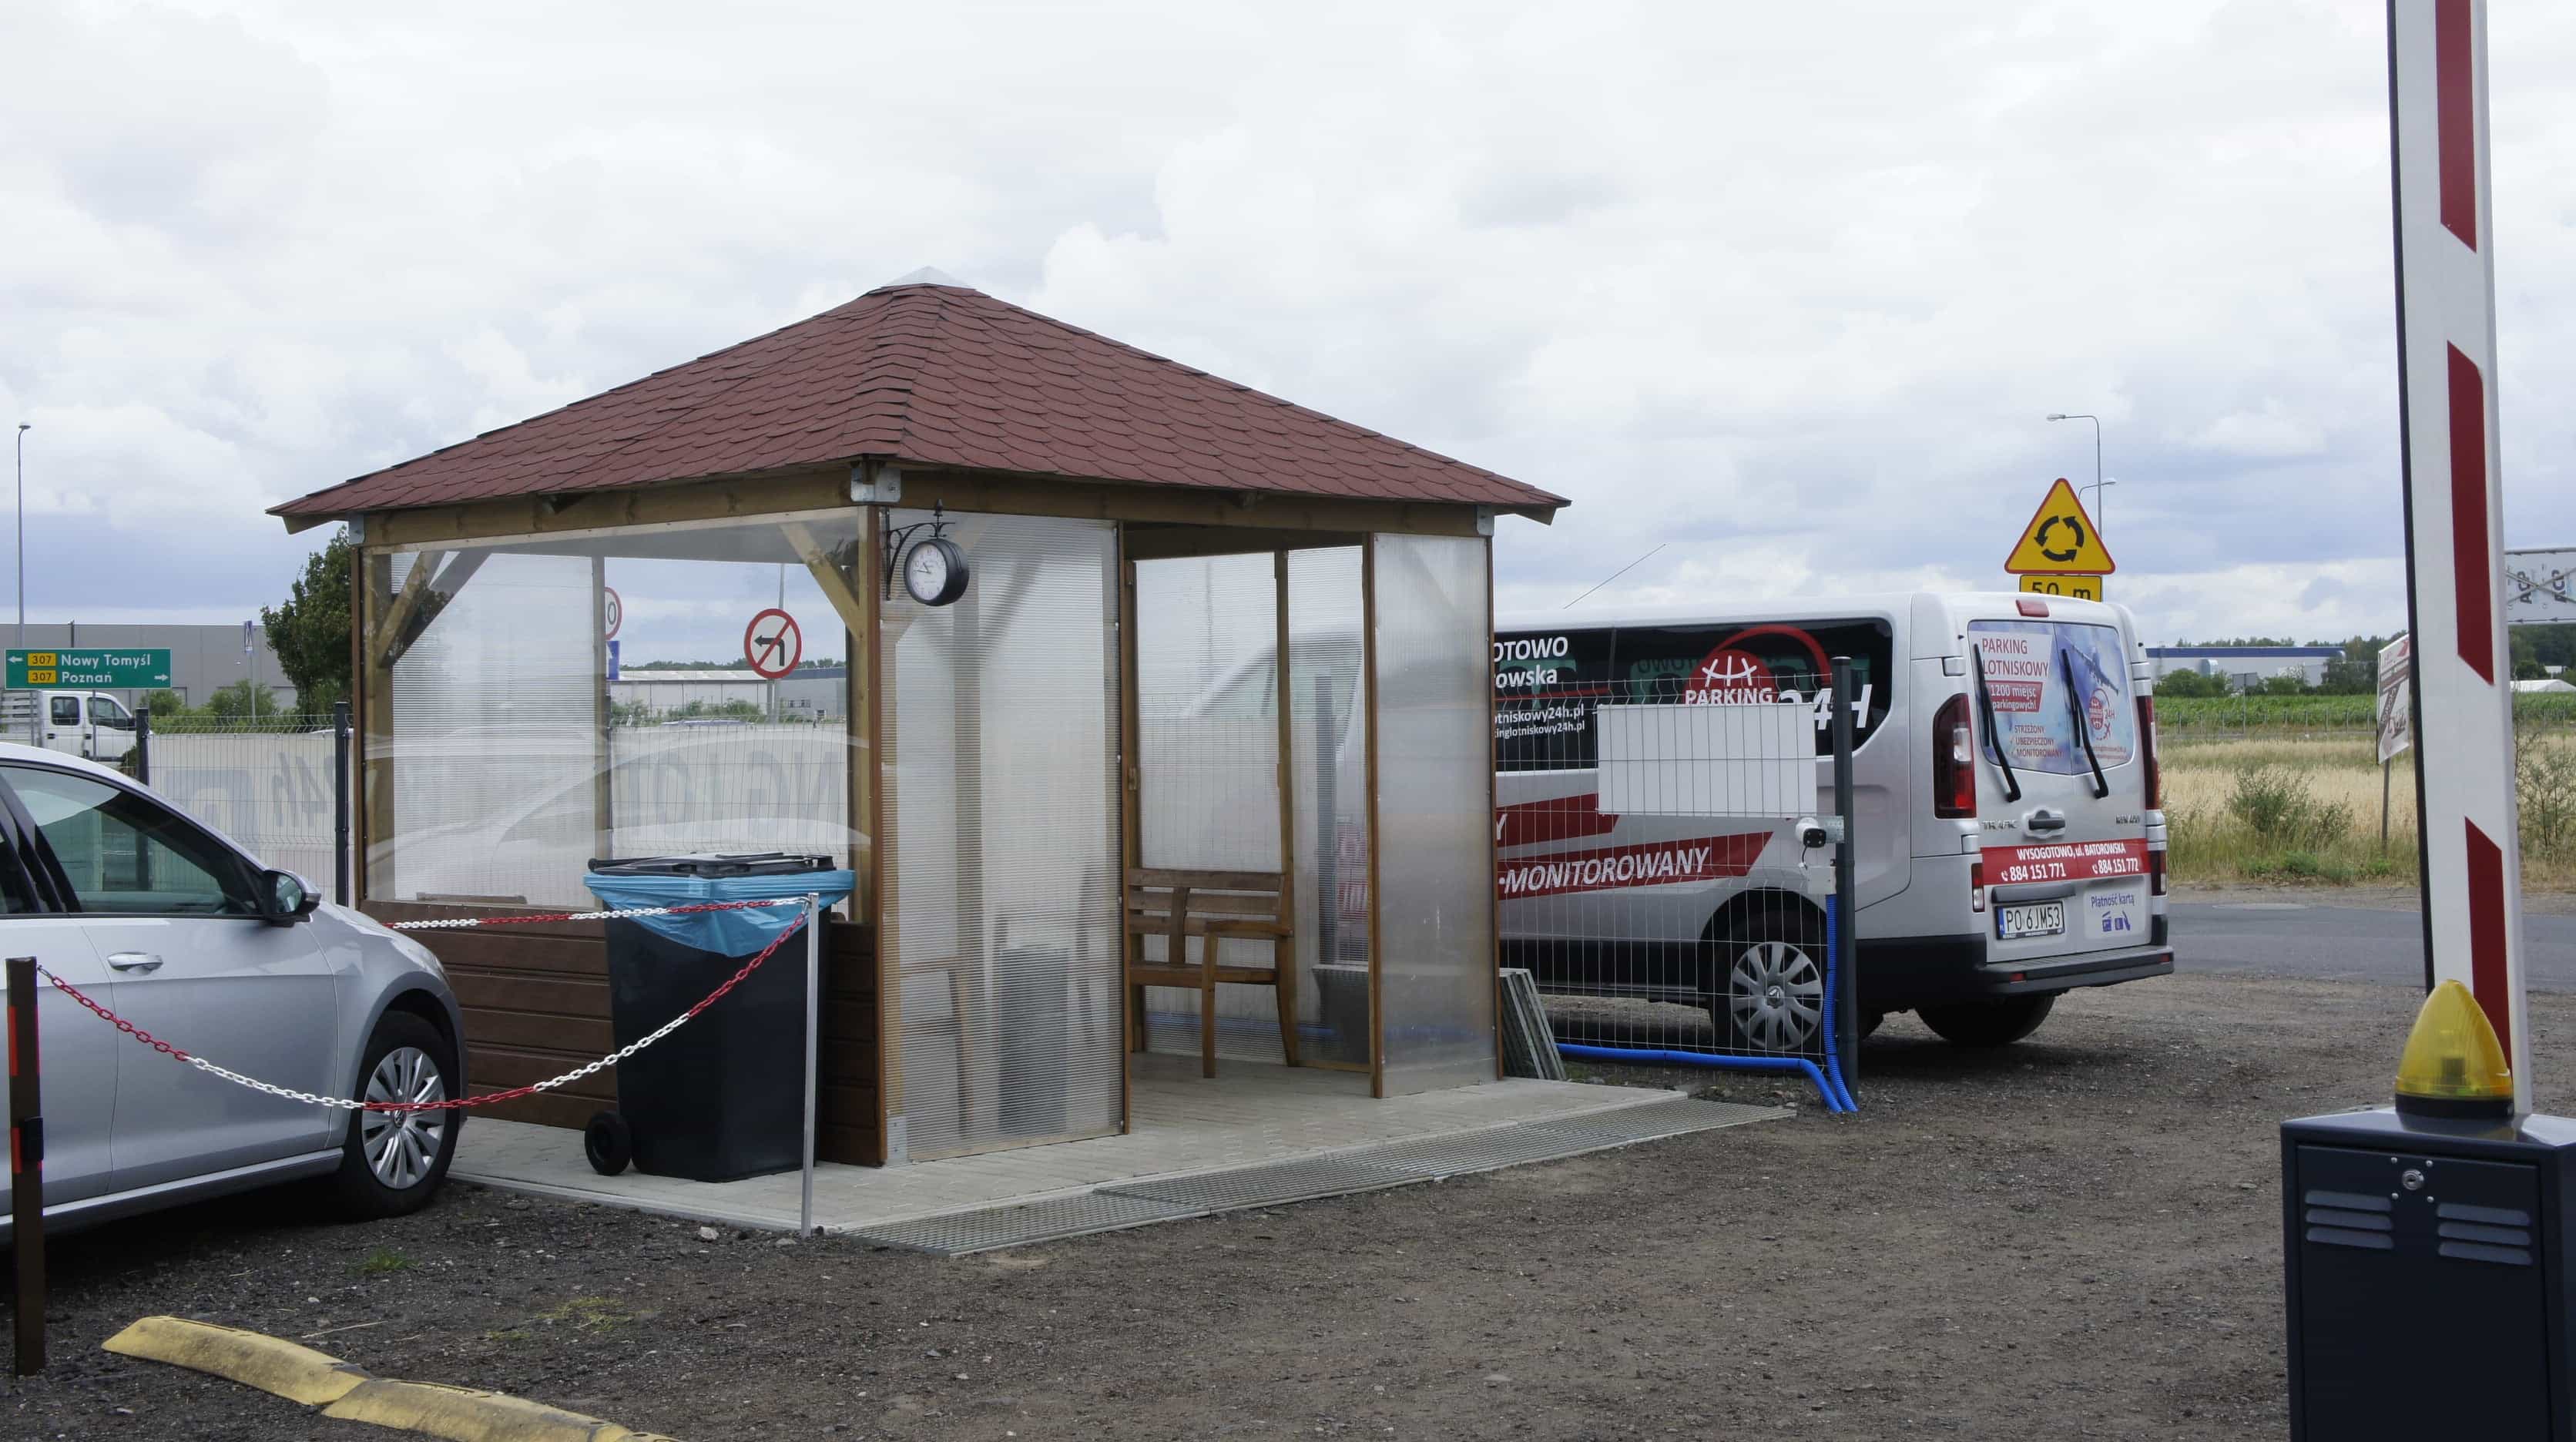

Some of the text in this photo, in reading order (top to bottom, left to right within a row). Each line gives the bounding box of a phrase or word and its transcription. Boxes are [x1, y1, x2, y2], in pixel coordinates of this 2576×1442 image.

[2073, 589, 2090, 600] m
[1982, 638, 2028, 654] PARKING
[33, 653, 151, 669] 307 Nowy Tomyśl
[1983, 659, 2049, 676] LOTNISKOWY
[32, 671, 112, 683] 307 Poznań
[1494, 664, 1557, 689] owska
[1685, 688, 1773, 705] PARKING
[1991, 684, 2011, 697] 1200
[1992, 699, 2037, 712] parkingowych!
[1494, 720, 1585, 739] inglotniskowy24h.pl
[2017, 843, 2126, 861] WYSOGOTOWO, ul. BATOROWSKA
[1504, 847, 1709, 894] MONITOROWANY
[2010, 863, 2066, 881] 884 151 771
[2098, 858, 2139, 874] 884 151 772
[2091, 894, 2135, 909] Płatność kartą
[2006, 907, 2061, 931] PO 6JM53
